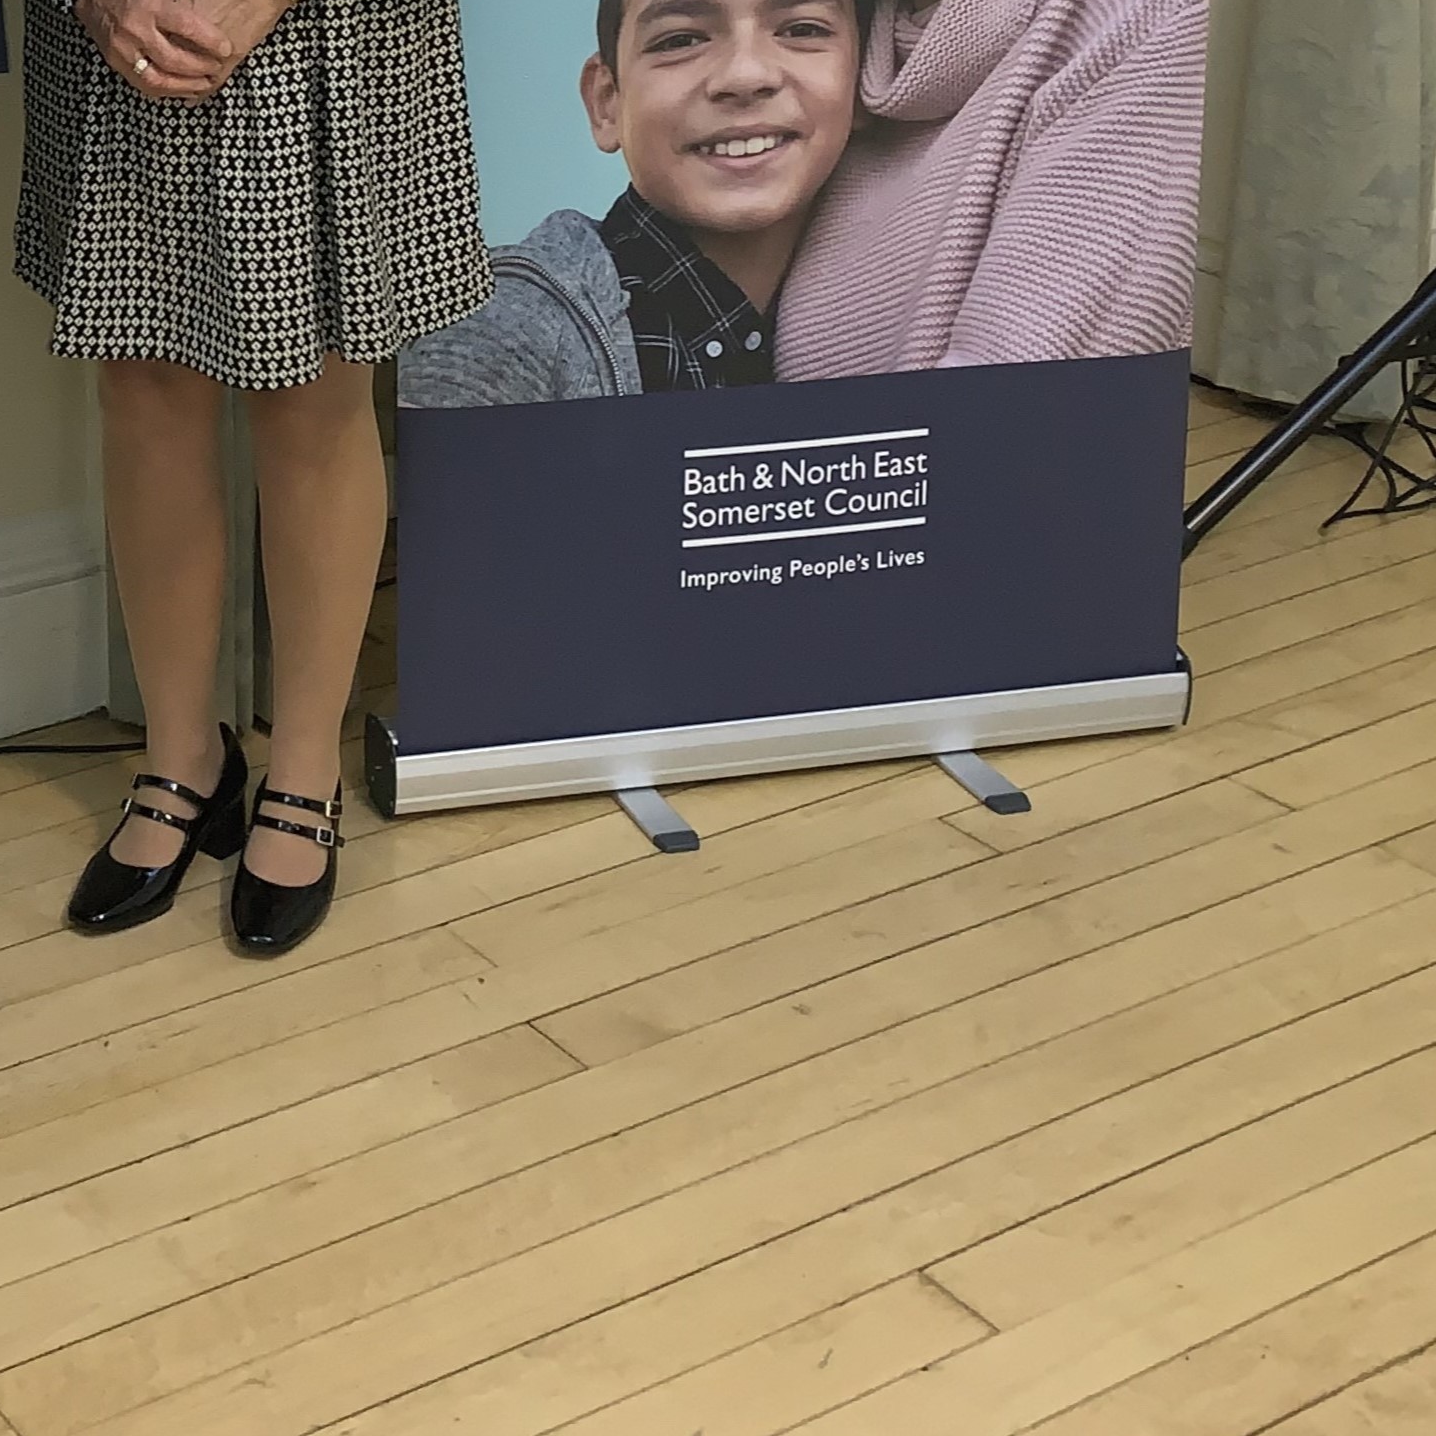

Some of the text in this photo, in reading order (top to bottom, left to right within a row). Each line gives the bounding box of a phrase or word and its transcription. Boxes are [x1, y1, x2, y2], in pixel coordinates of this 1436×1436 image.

[684, 450, 928, 496] Bath & North East
[682, 477, 928, 529] Somerset Council
[680, 549, 925, 591] Improving People’s Lives
